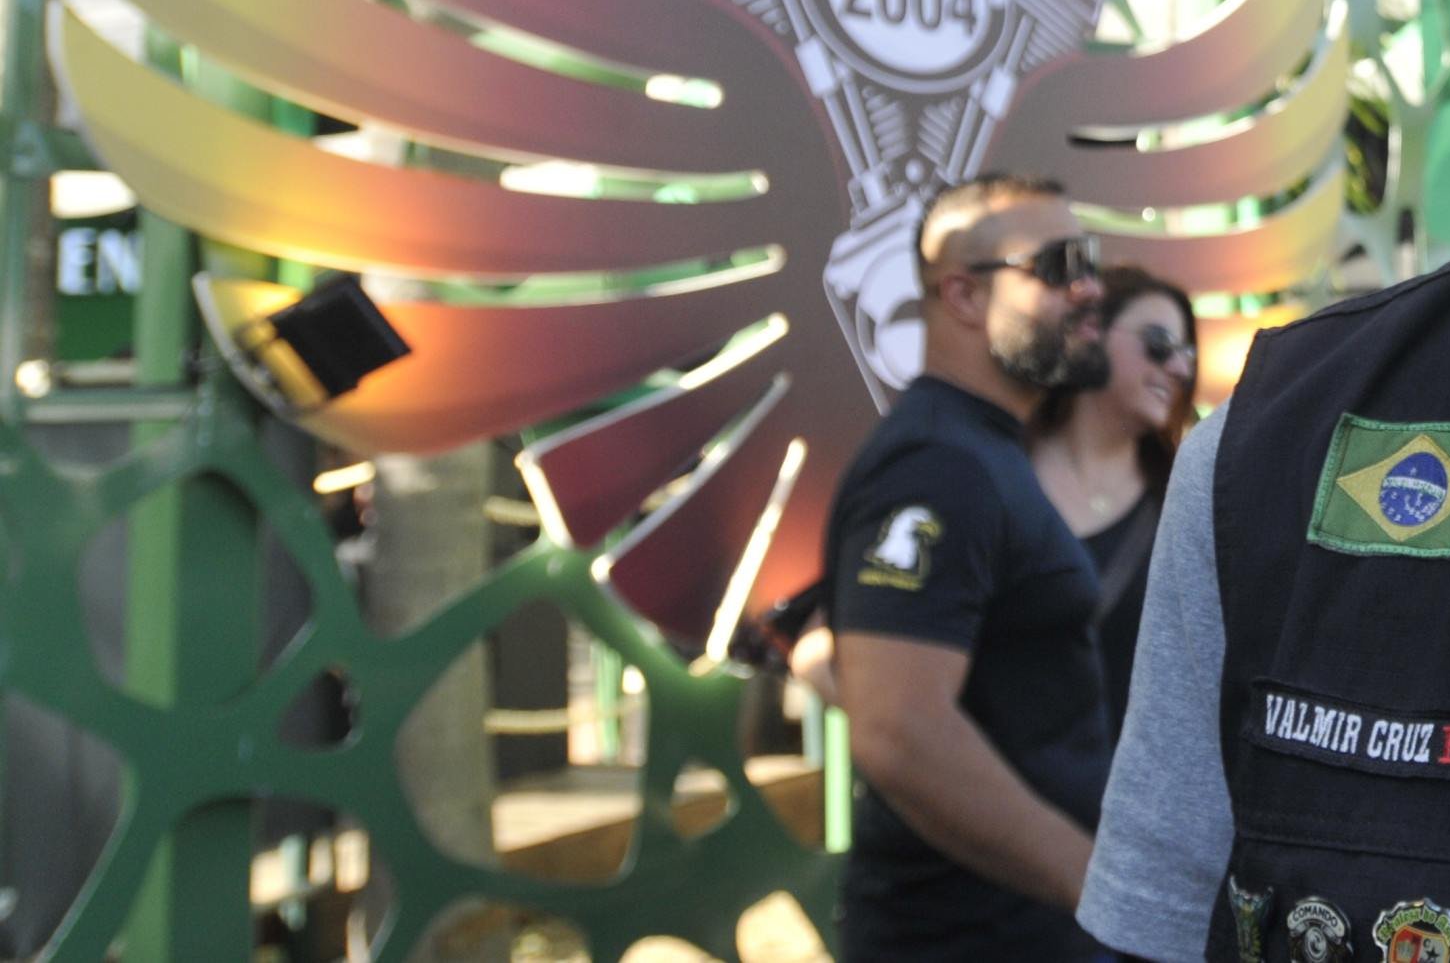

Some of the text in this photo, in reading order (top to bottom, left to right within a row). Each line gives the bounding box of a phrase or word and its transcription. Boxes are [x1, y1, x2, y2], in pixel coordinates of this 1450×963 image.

[1264, 693, 1362, 755] VALMIR
[1367, 720, 1435, 763] CRUZ
[1292, 904, 1338, 928] COMANDO
